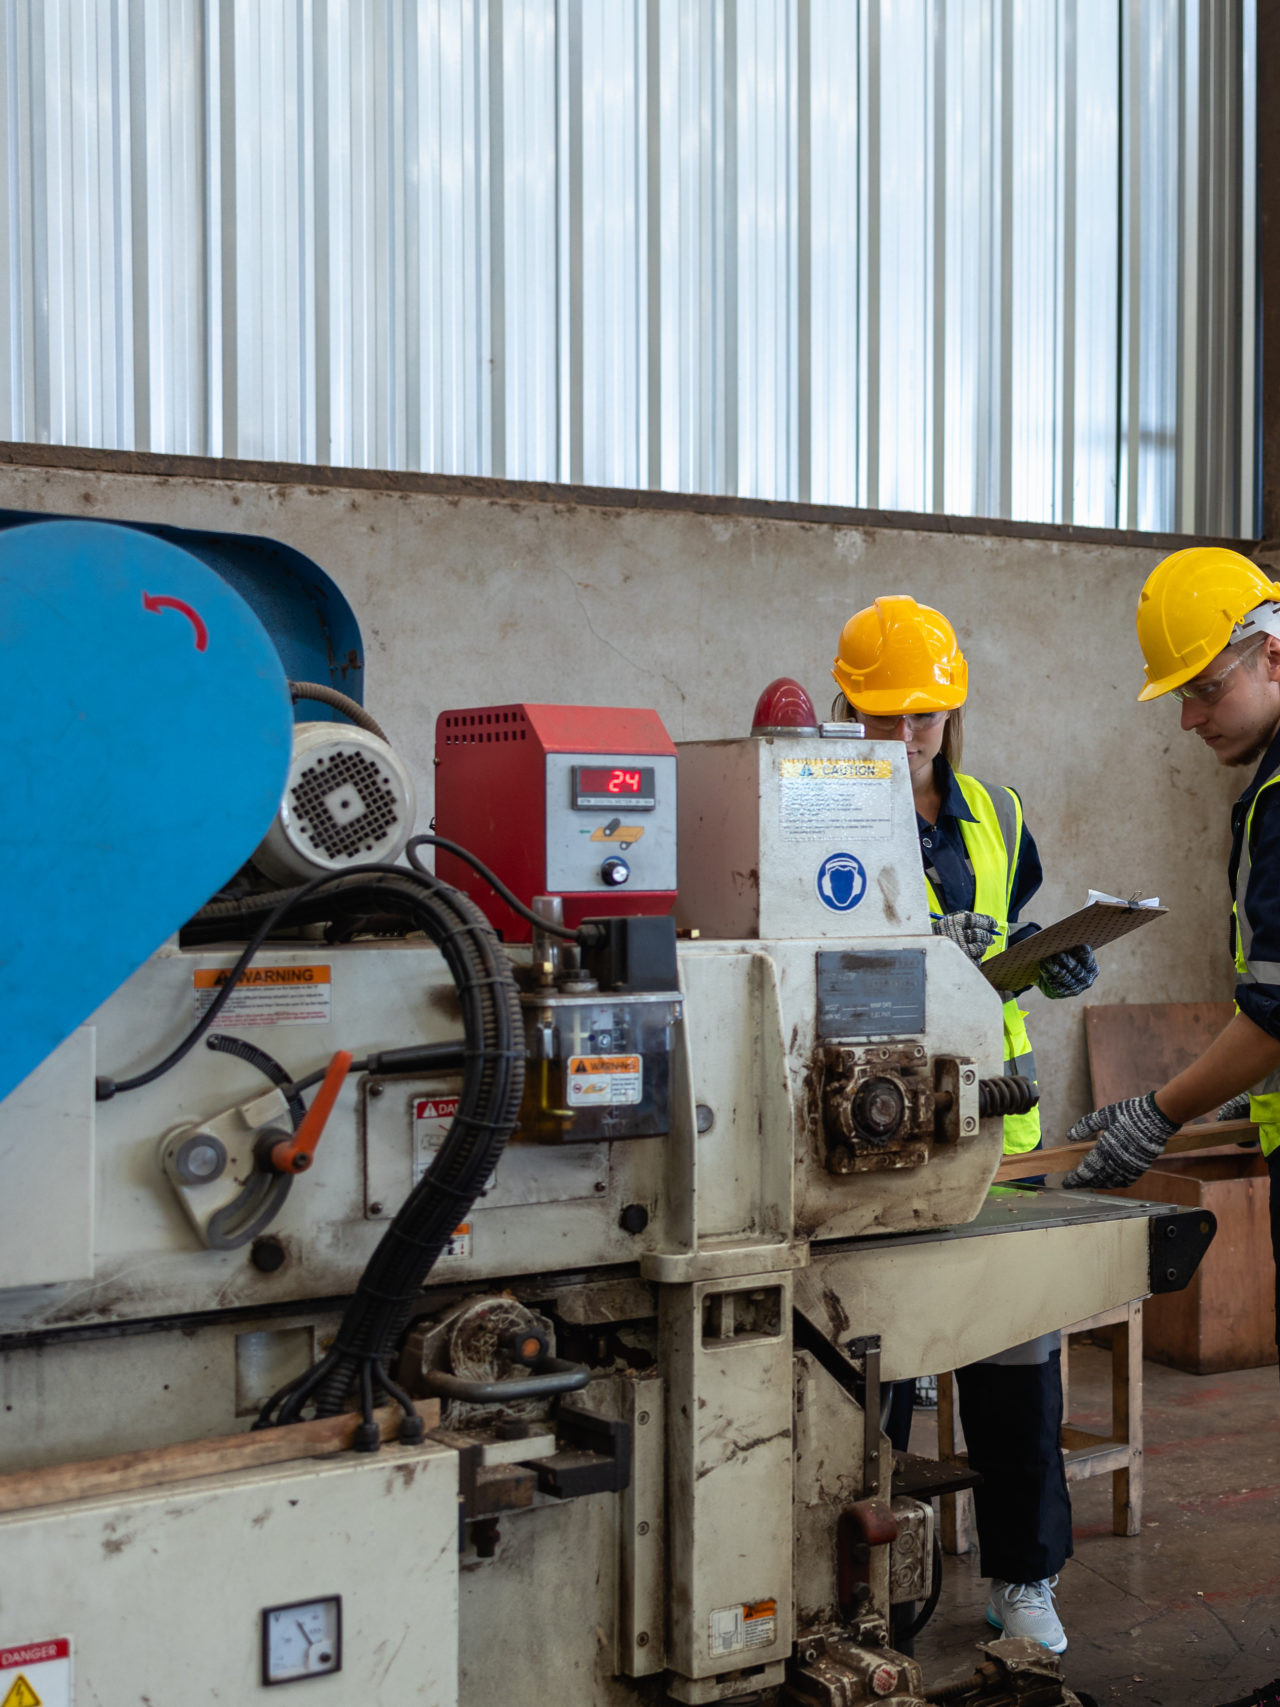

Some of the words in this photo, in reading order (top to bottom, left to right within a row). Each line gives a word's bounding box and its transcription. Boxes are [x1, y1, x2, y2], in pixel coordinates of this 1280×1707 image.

[822, 764, 876, 776] CAUTION
[608, 769, 641, 793] 24
[239, 968, 314, 983] WARNING
[2, 1644, 57, 1666] DANGER
